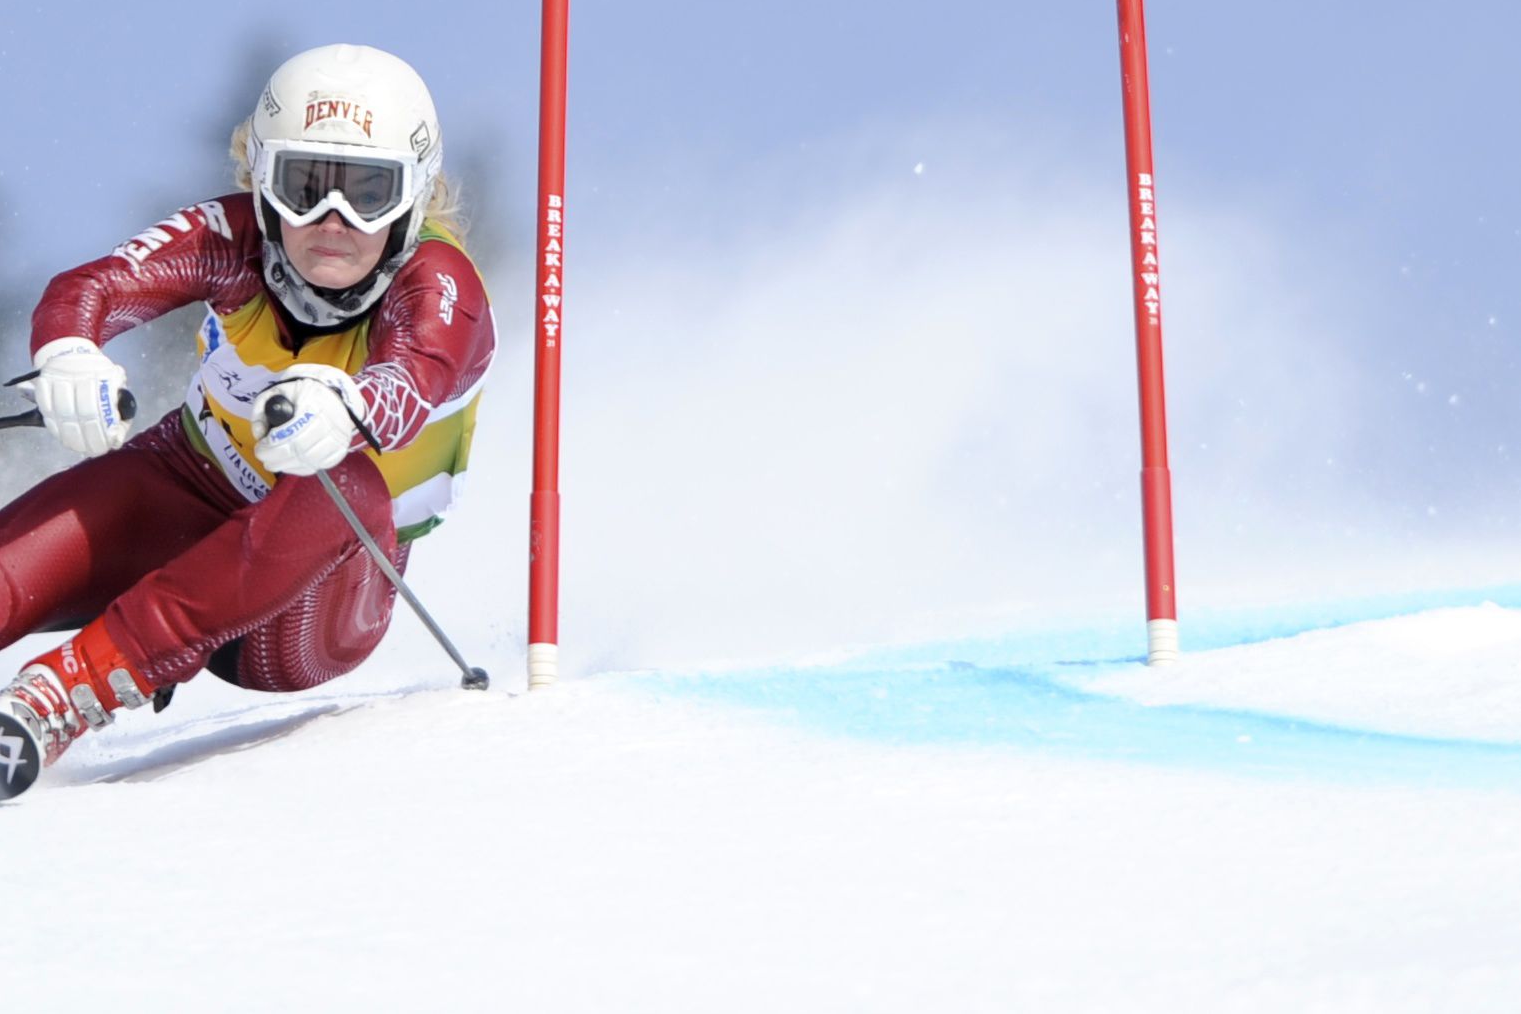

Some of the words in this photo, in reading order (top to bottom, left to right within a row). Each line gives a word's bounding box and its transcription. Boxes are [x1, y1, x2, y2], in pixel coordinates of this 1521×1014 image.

[304, 100, 374, 138] DENVER
[99, 379, 115, 428] HESTRA
[271, 412, 314, 442] HESTRA
